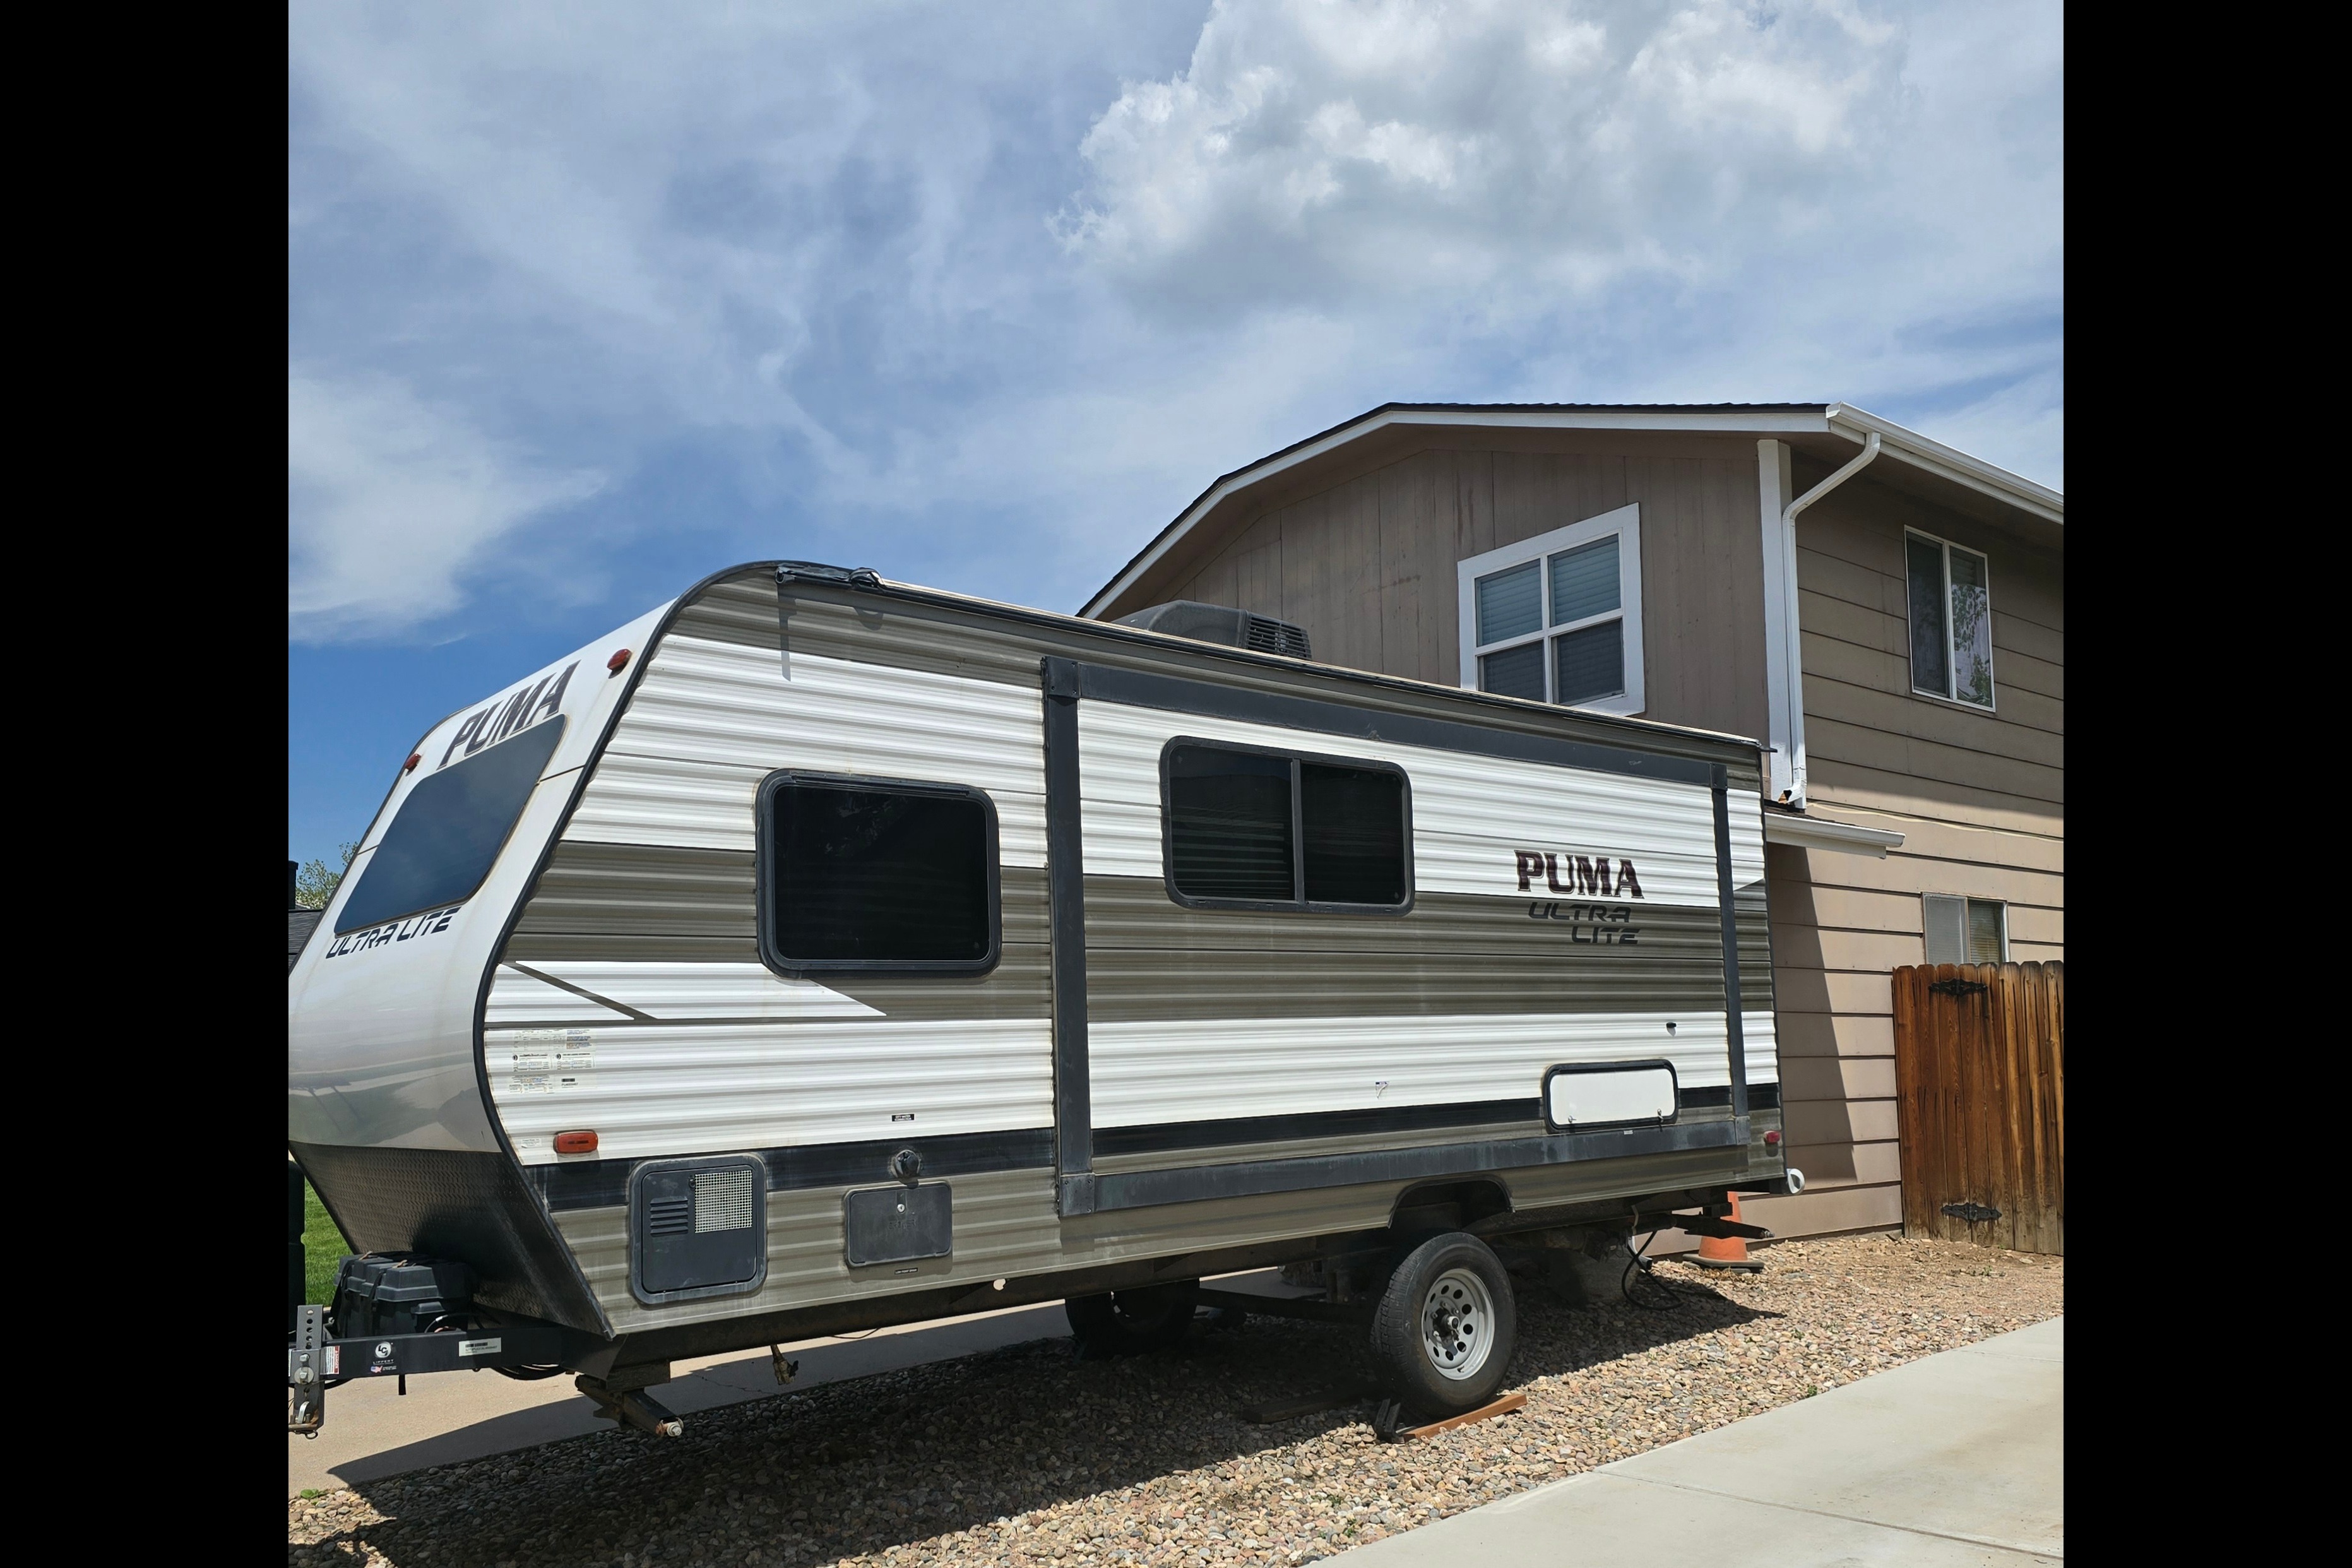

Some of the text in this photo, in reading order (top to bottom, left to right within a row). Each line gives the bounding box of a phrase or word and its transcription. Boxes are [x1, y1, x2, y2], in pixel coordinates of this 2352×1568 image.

[436, 659, 581, 771] PUMA
[1514, 850, 1644, 899] PUMA
[326, 906, 461, 959] ULTRA LITE
[1528, 901, 1632, 923] ULTRA
[1571, 926, 1641, 944] LITE
